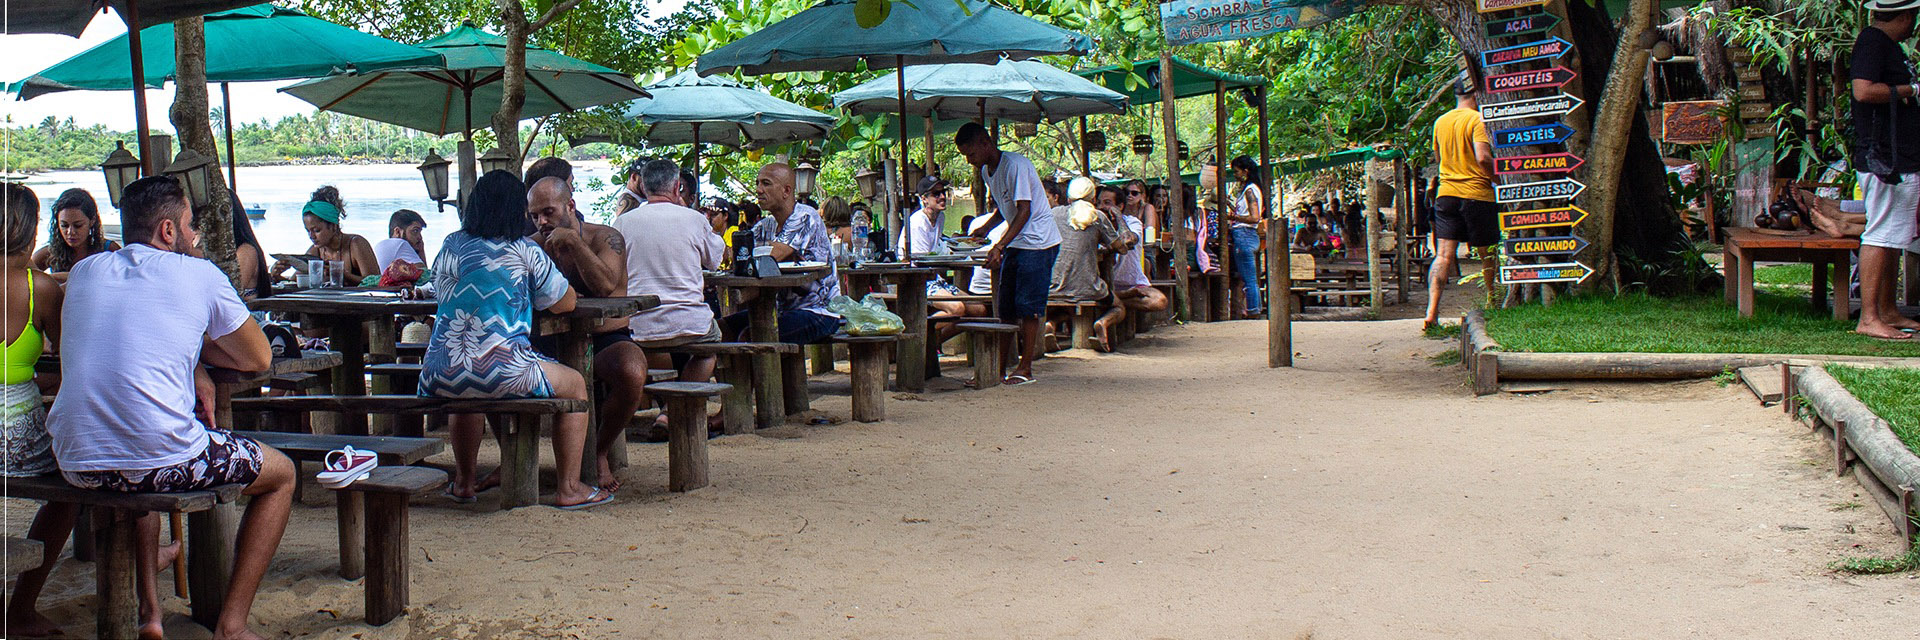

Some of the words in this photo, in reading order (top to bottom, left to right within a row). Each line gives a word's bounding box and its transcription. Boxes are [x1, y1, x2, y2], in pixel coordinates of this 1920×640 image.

[1187, 1, 1254, 20] SOMBRA
[1230, 14, 1296, 34] FRESCA
[1522, 46, 1538, 58] MEU
[1539, 42, 1561, 55] AMOR
[1494, 72, 1553, 88] COQUETÉIS
[1508, 128, 1556, 143] PASTÉIS
[1504, 160, 1510, 171] I
[1523, 157, 1567, 170] CARAIVA
[1522, 182, 1575, 198] EXPRESSO
[1511, 213, 1547, 225] COMIDA
[1550, 211, 1571, 222] BOA
[1514, 239, 1577, 253] CARAIVANDO
